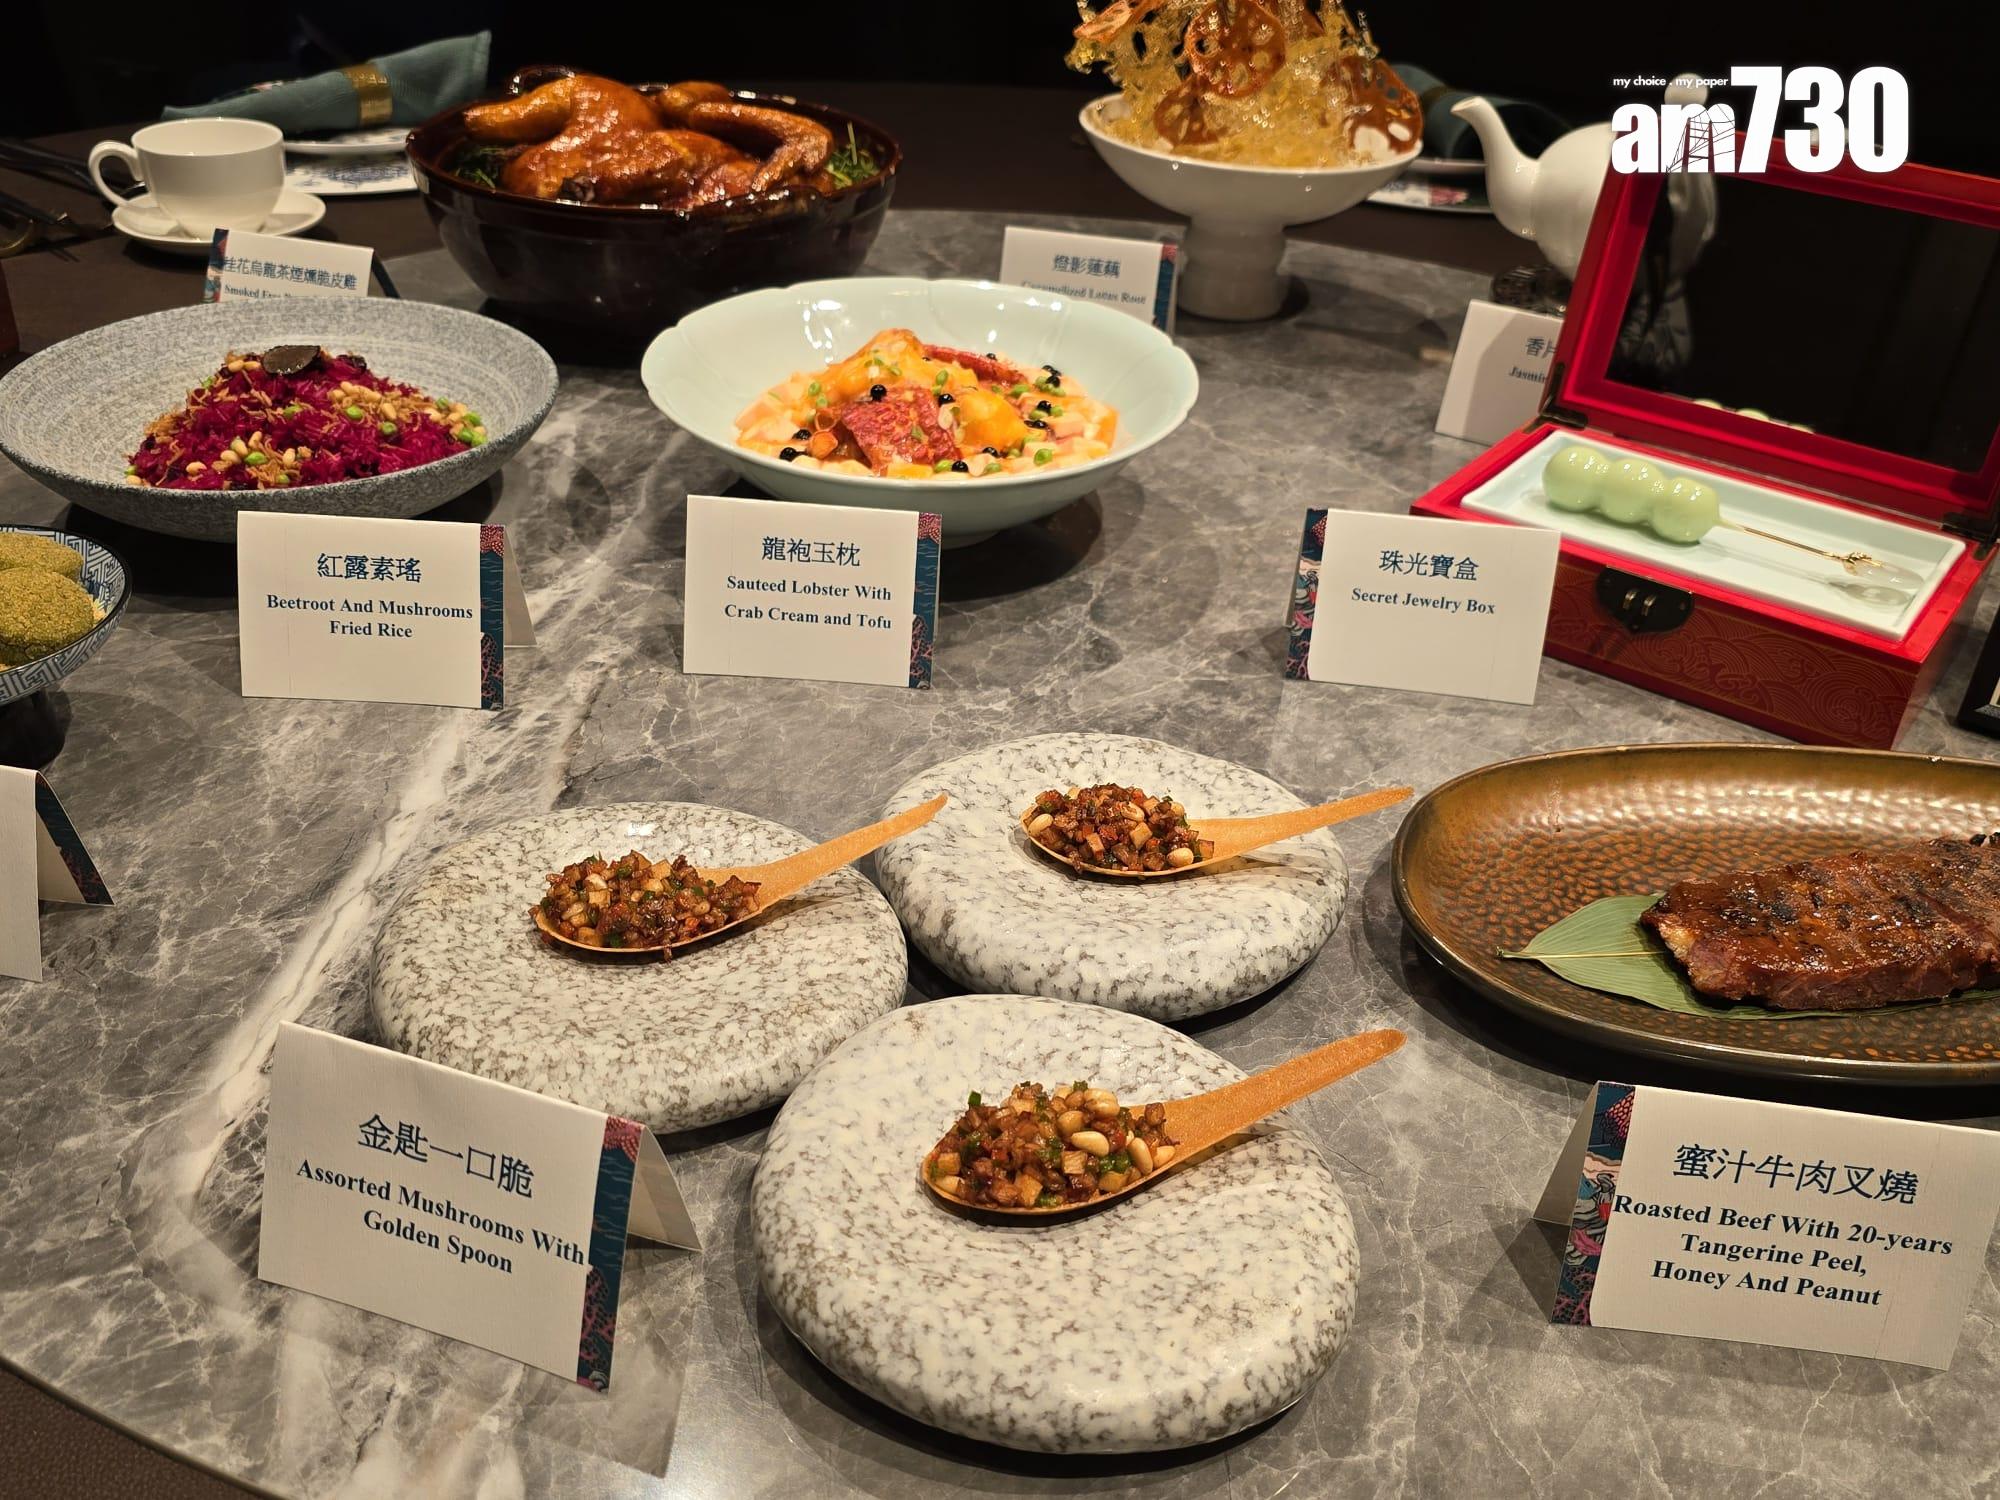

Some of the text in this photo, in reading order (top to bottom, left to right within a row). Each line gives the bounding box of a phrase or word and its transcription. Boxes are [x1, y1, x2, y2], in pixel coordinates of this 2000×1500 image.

[762, 536, 861, 567] 龍袍玉枕
[1379, 550, 1479, 581] 珠光寶盒
[317, 553, 422, 583] 紅露素瑤
[727, 575, 892, 601] Sauteed Lobster With
[1351, 587, 1496, 615] Secret Jewelry Box
[267, 594, 473, 619] Beetroot And Mushrooms
[724, 604, 892, 629] Crab Cream and Tofu
[330, 620, 413, 638] Fried Rice
[358, 1113, 535, 1199] 金匙一口脆
[1673, 1143, 1920, 1205] 蜜汁牛肉叉燒
[297, 1159, 585, 1266] Assorted Mushrooms With
[1612, 1194, 1953, 1255] Roasted Beef With 20-years
[363, 1209, 513, 1274] Golden Spoon
[1681, 1232, 1867, 1278] Tangerine Peel,
[1651, 1258, 1883, 1306] Honey And Peanut
